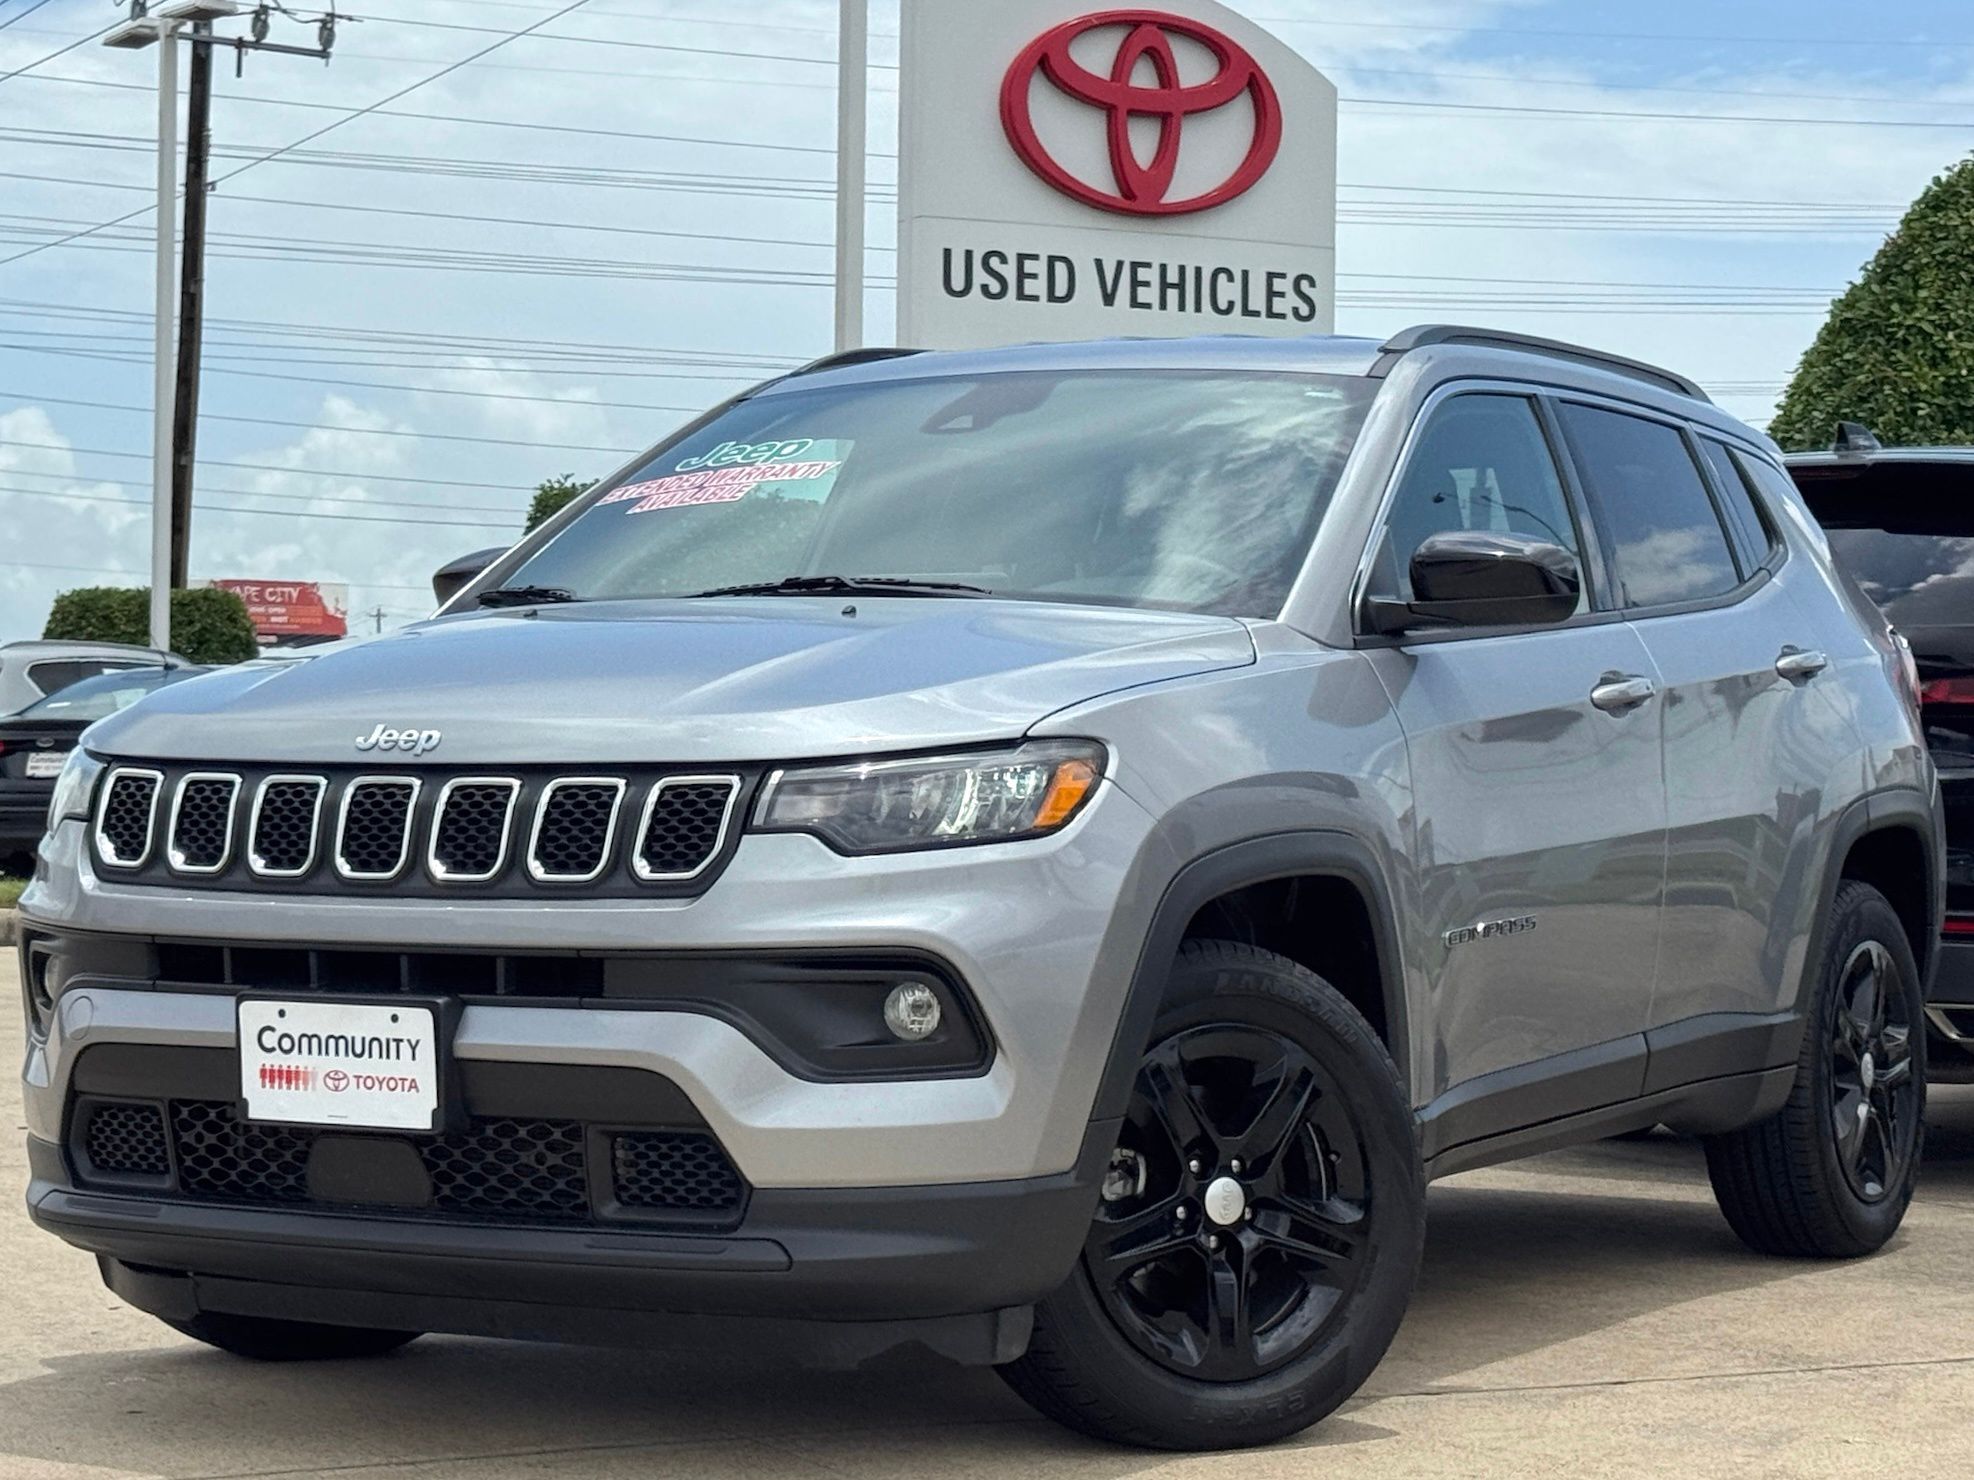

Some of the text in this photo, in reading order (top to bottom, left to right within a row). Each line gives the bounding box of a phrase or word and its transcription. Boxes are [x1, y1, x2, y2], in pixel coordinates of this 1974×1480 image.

[943, 247, 1318, 323] USED VEHICLES
[675, 439, 814, 471] Jeep
[709, 461, 840, 487] WARRANTY
[631, 483, 755, 513] AVAILABLE
[265, 586, 302, 604] CITY
[355, 723, 441, 757] Jeep
[1444, 915, 1537, 946] COMPASS
[353, 1075, 420, 1093] TOYOTA
